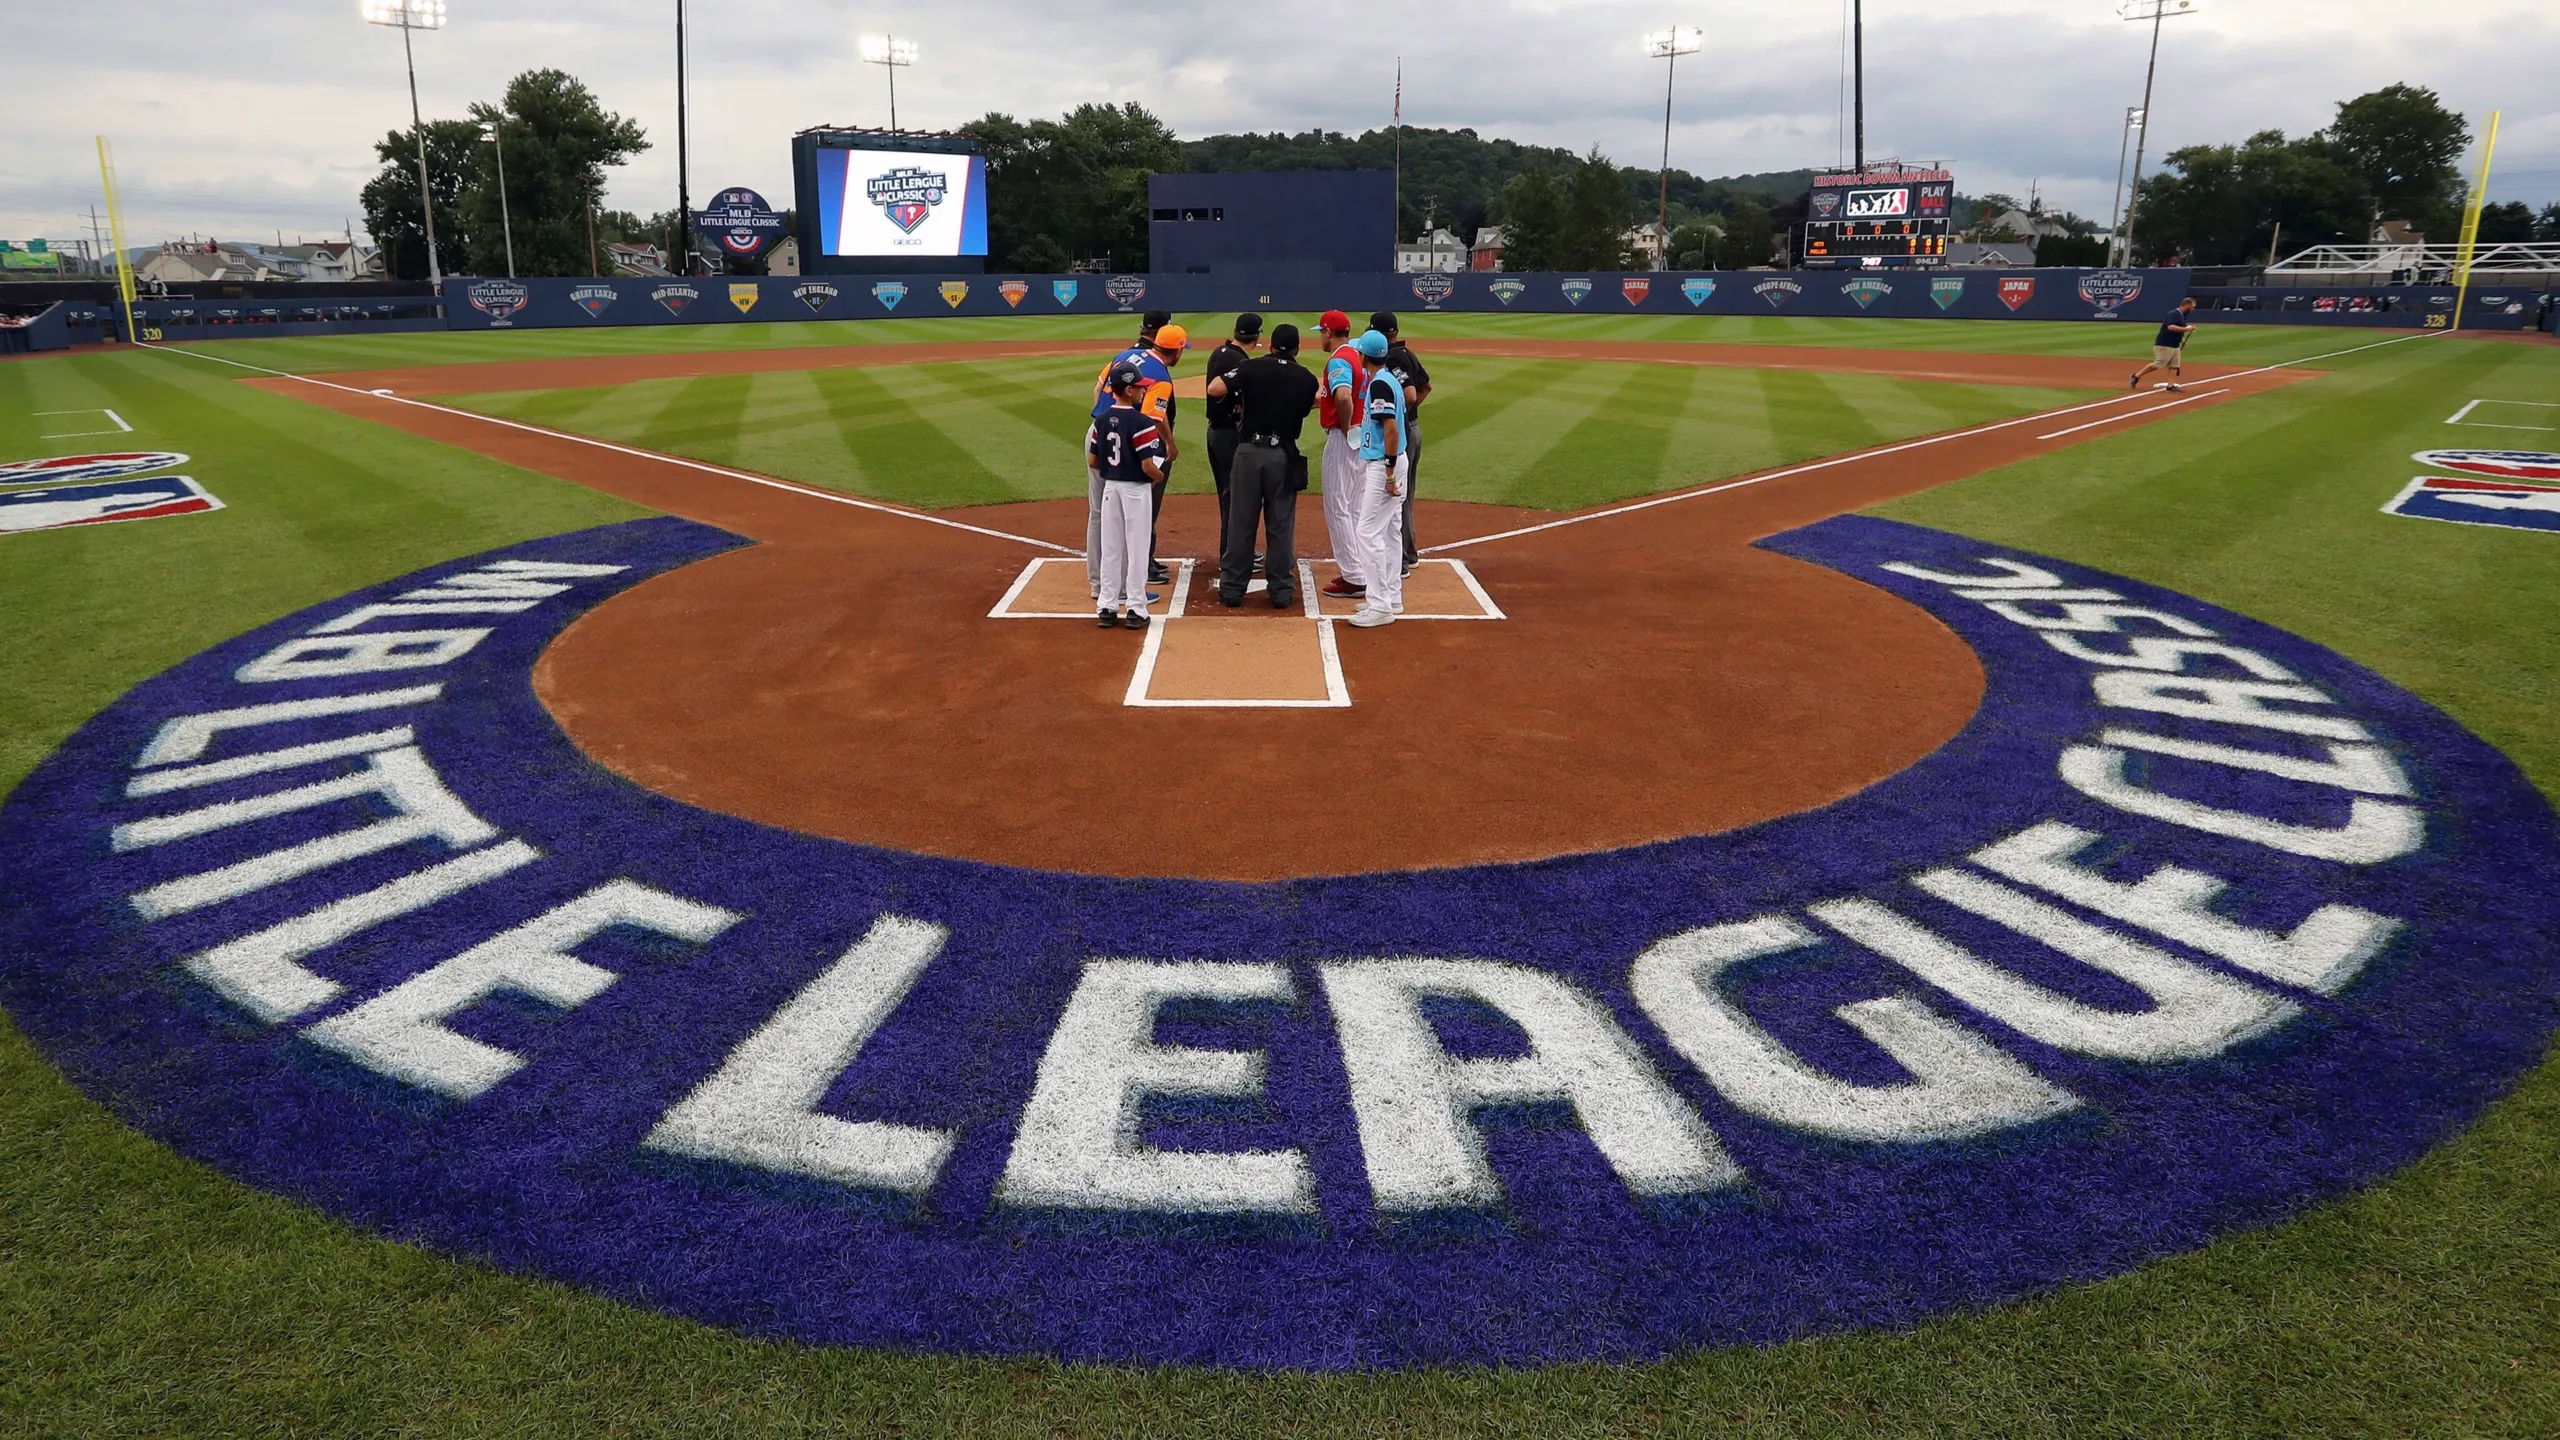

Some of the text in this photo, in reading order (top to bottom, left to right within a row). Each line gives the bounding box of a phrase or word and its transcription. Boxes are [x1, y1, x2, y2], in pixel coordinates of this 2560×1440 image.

[896, 170, 913, 178] MLB
[1814, 169, 1950, 187] HISTORIC BOWMAN FIELD
[869, 176, 944, 192] LITTLE LEAGUE
[886, 189, 926, 202] CLASSIC
[1921, 185, 1946, 197] PLAY
[1920, 197, 1945, 208] BALL
[729, 209, 751, 218] MLB
[700, 217, 780, 227] LITTLE LEAGUE CLASSIC
[1915, 257, 1939, 265] @MLB
[793, 285, 839, 298] NEW ENGLAND
[1489, 281, 1526, 293] ASIA-PACIFIC
[1561, 281, 1593, 291] AUSTRALIA
[1624, 281, 1648, 290] CANADA
[1752, 281, 1802, 294] EUROPE-AFRICA
[1841, 281, 1893, 295] LATIN AMERICA
[1933, 281, 1962, 291] MEXICO
[2003, 281, 2030, 291] JAPAN
[570, 288, 618, 302] GREAT LAKES
[651, 287, 699, 301] MID-ATLANTIC
[2424, 314, 2447, 328] 328
[142, 328, 163, 340] 320
[1107, 431, 1121, 466] 3
[109, 557, 2426, 1212] MLB LITTLE LEAGUE CLASSIC
